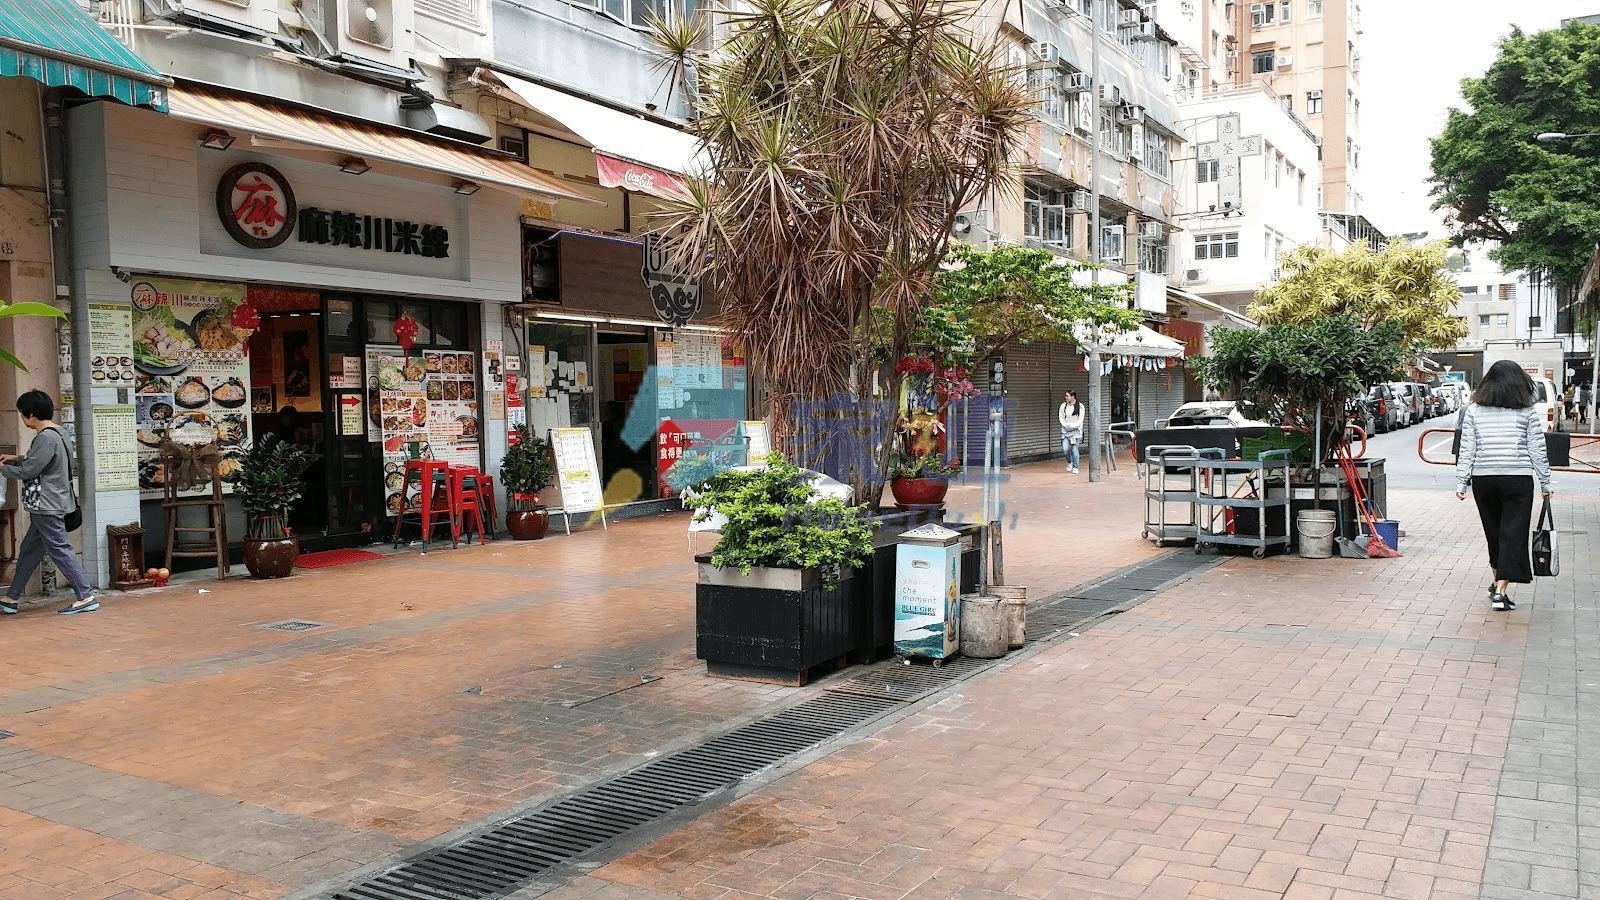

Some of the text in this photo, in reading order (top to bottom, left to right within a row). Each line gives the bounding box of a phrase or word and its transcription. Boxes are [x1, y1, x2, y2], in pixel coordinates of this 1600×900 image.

[234, 175, 287, 227] 麻
[903, 577, 928, 586] share
[902, 586, 917, 595] the
[902, 595, 937, 605] moment
[901, 604, 919, 612] BLUE
